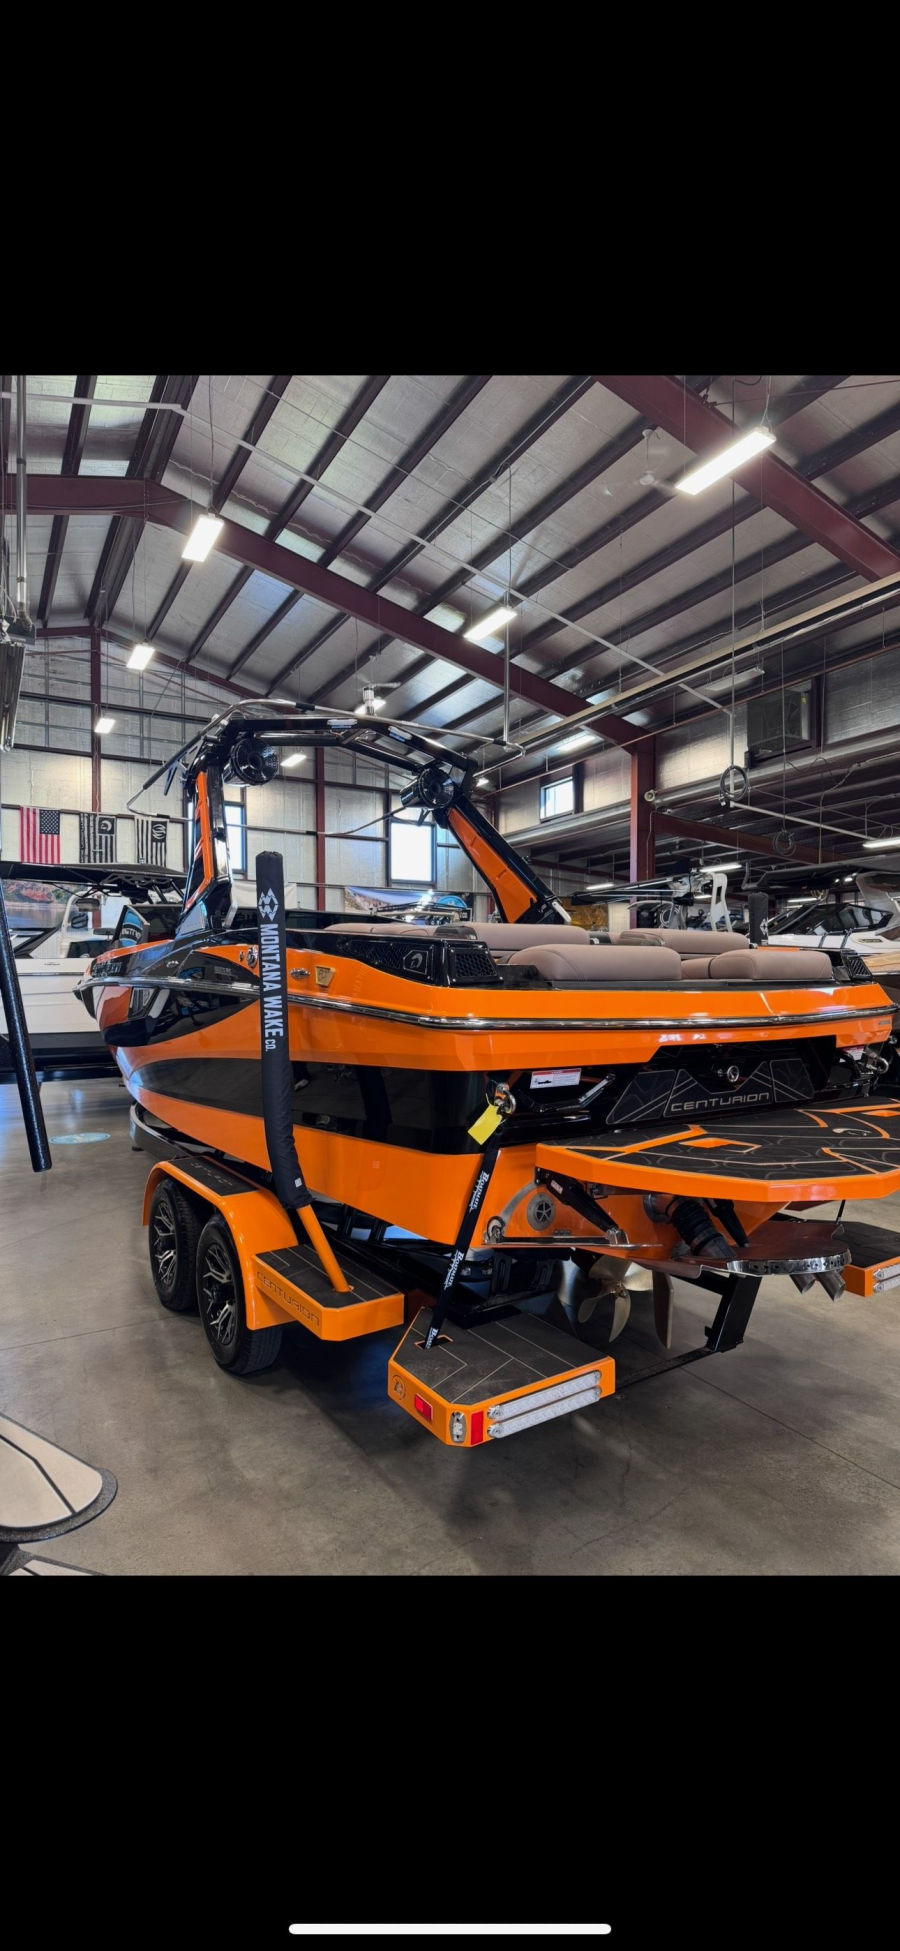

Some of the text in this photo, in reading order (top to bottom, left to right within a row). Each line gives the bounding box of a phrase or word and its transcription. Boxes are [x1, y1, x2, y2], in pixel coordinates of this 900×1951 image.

[260, 923, 281, 992] MONTANA
[263, 995, 284, 1038] WAKE
[670, 1092, 770, 1112] CENTURION
[257, 1271, 320, 1327] CENTURION
